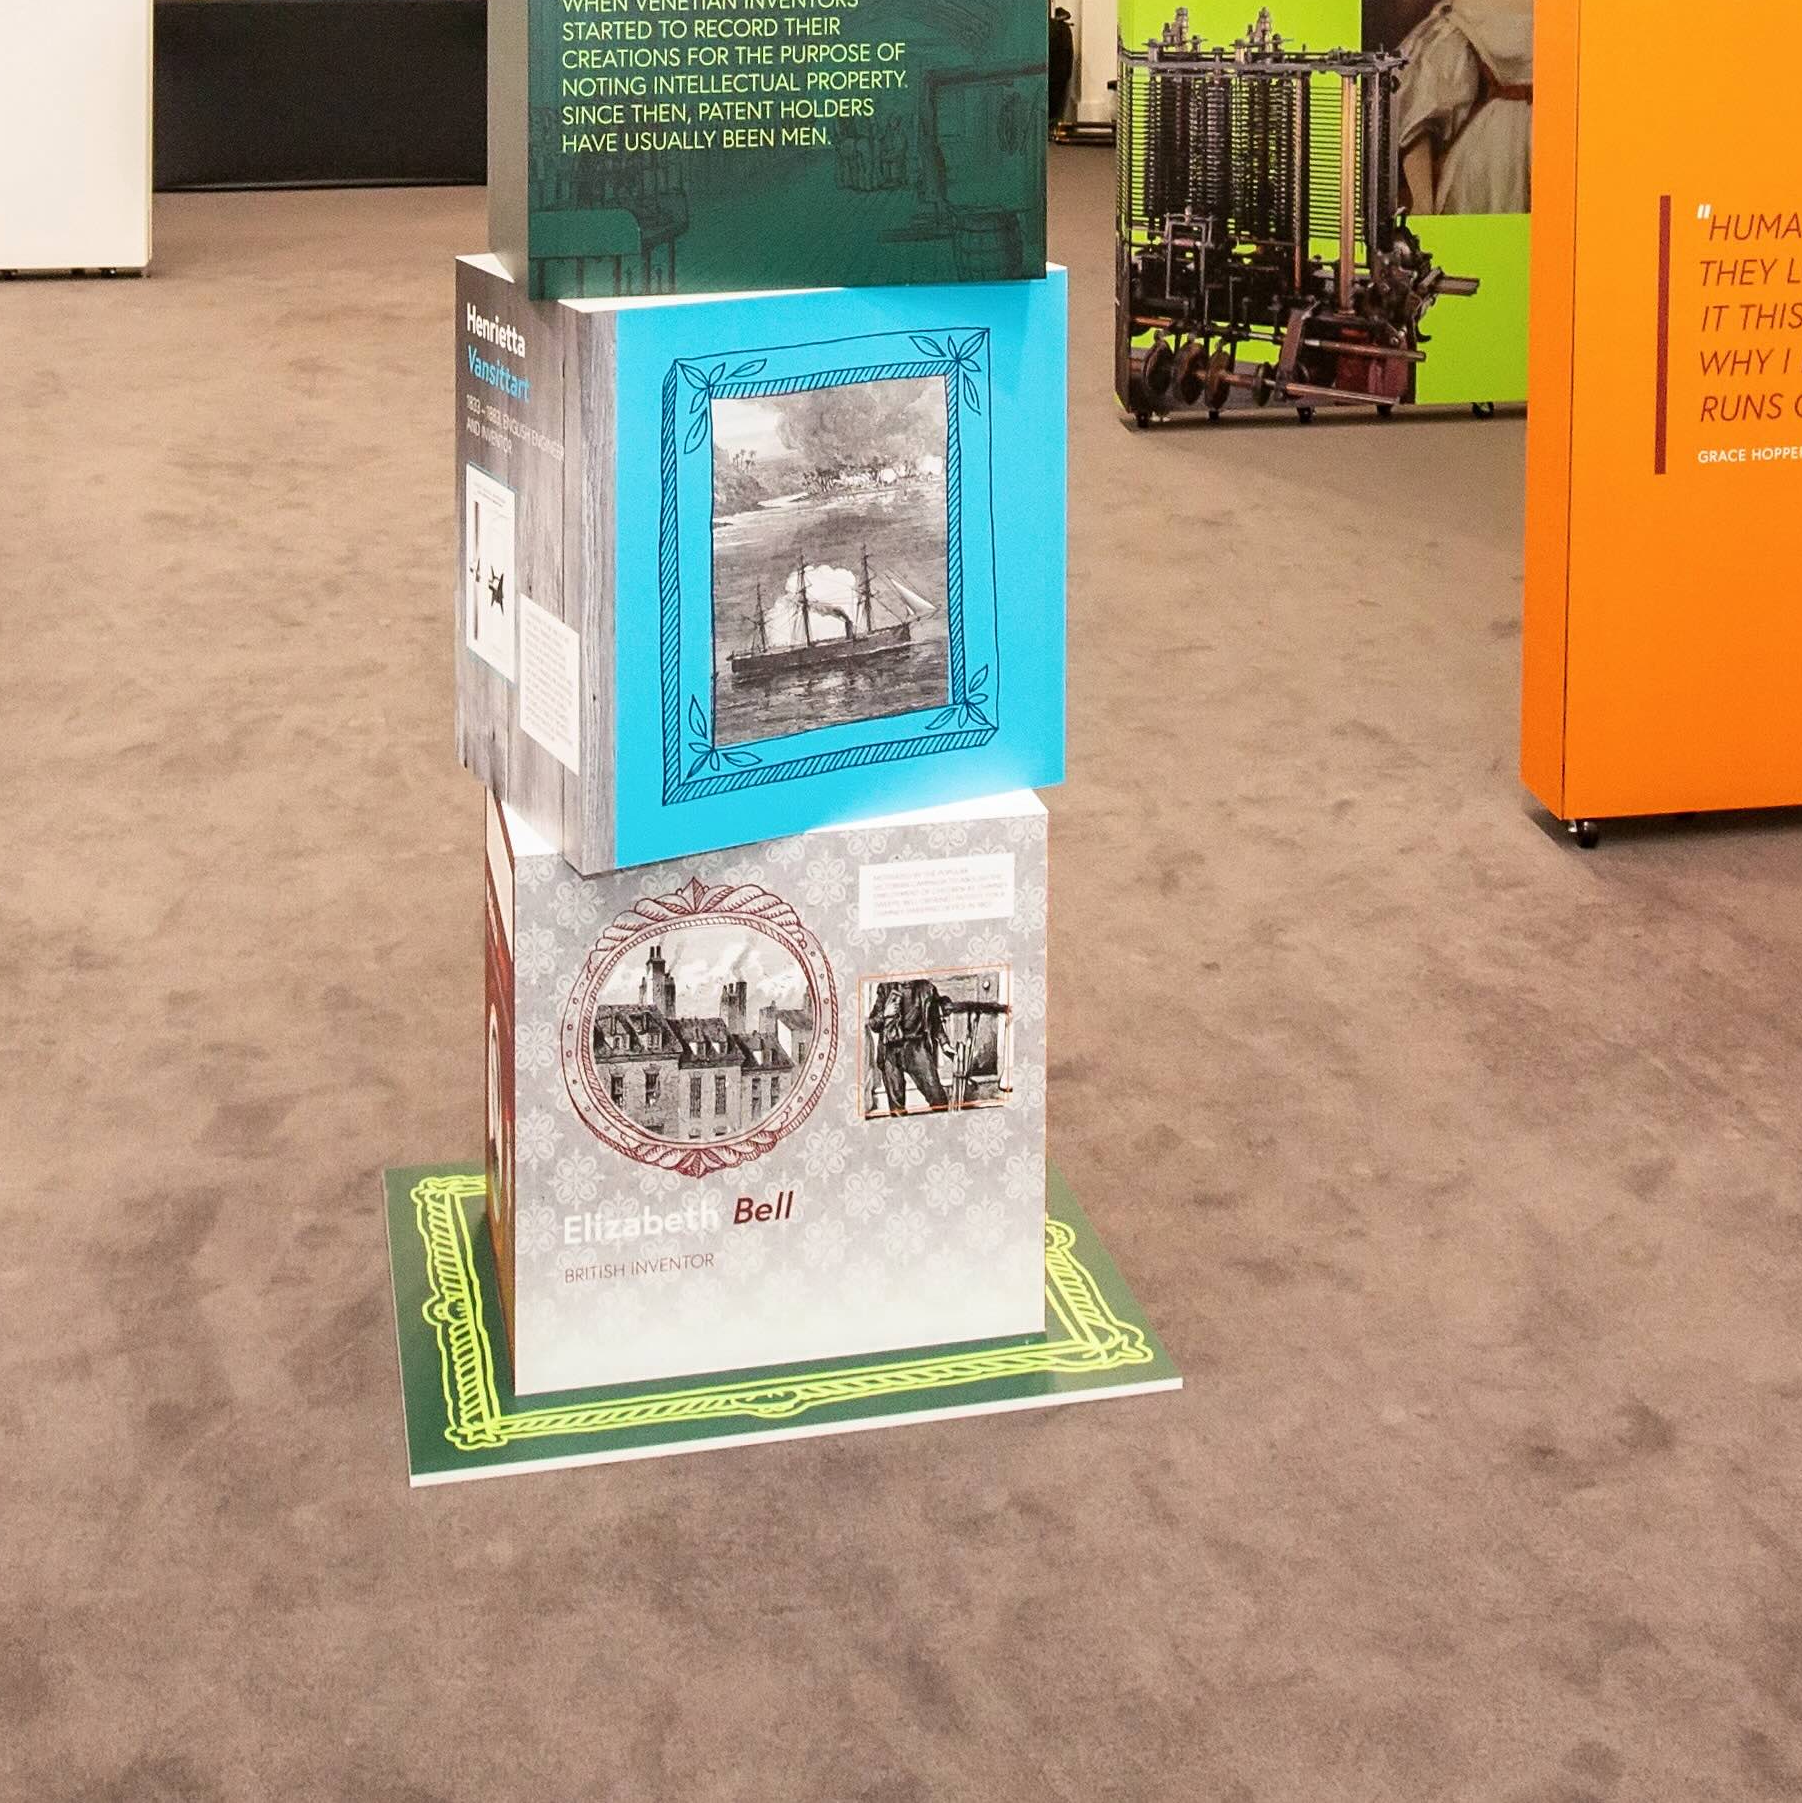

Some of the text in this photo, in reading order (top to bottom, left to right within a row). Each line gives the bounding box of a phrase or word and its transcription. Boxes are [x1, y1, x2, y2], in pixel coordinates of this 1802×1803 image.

[562, 70, 906, 97] NOTING INTELLECTUAL PROPERTY.
[562, 126, 832, 153] HAVE USUALLY BEEN MEN.
[467, 302, 526, 358] Henrietta
[468, 345, 530, 403] Vansittart
[1700, 392, 1784, 423] RUNS
[1697, 448, 1747, 464] GRACE
[564, 1190, 794, 1245] Elizabeth Bell
[565, 1252, 714, 1284] BRITISH INVENTOR
